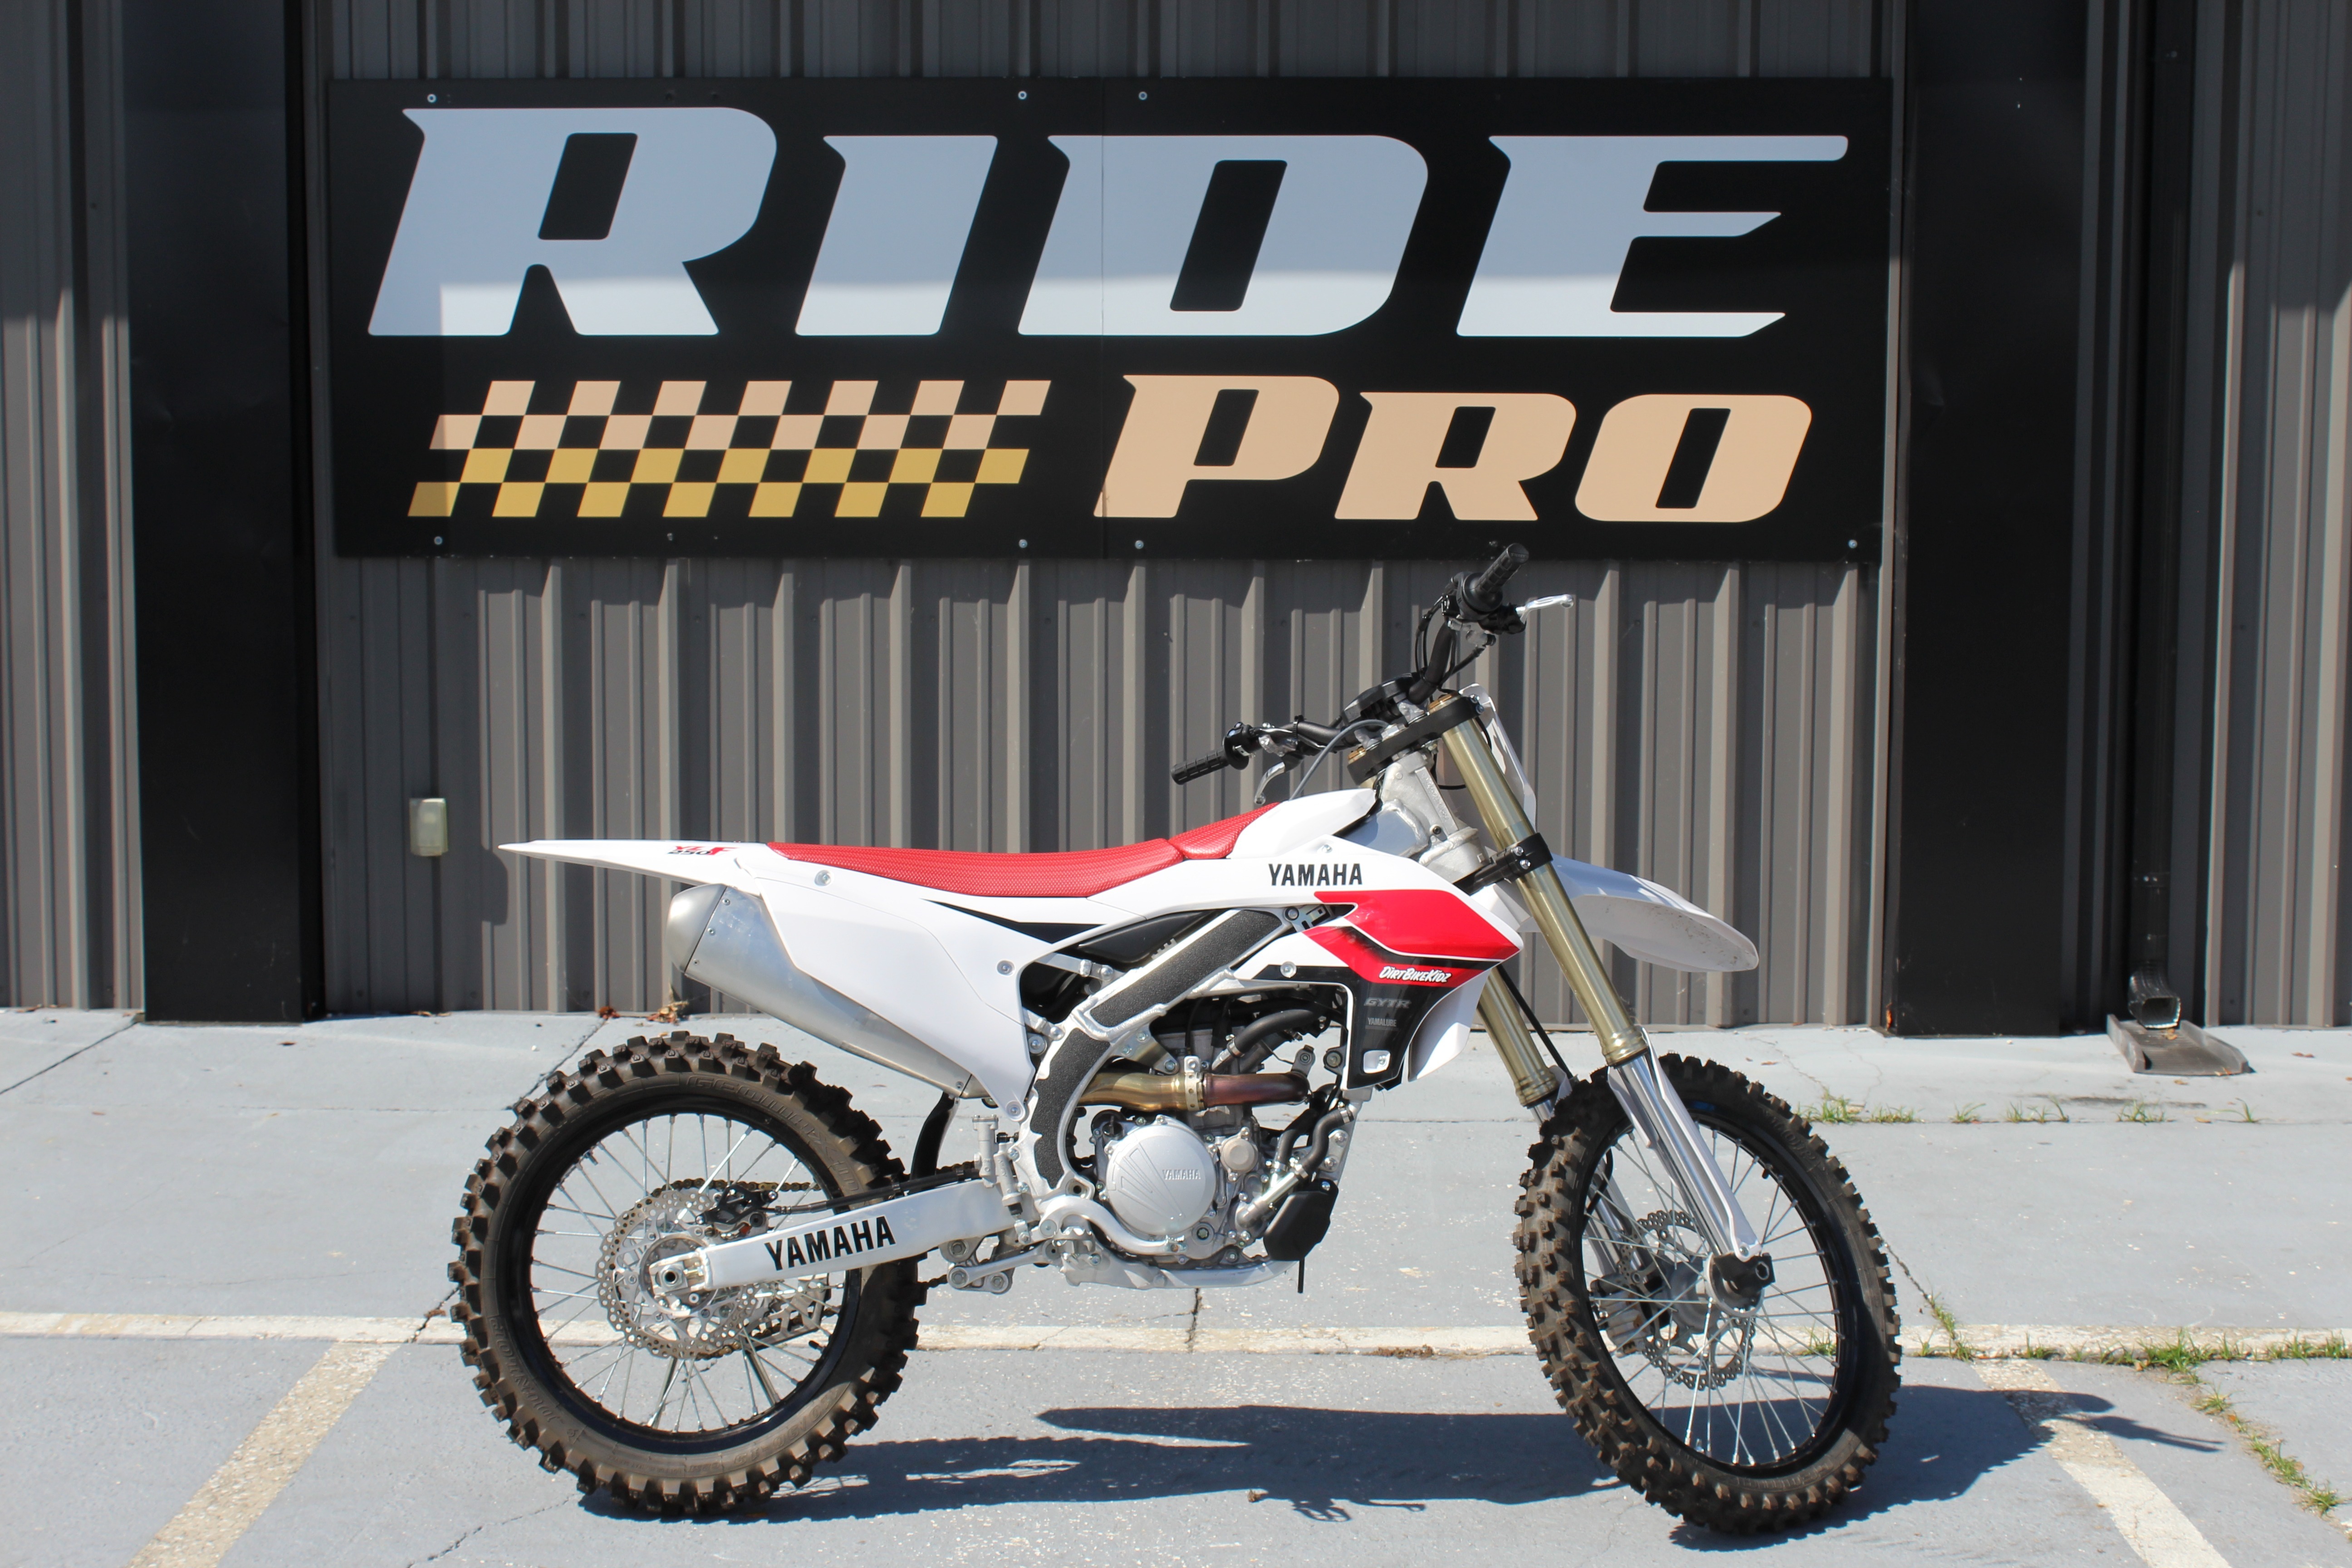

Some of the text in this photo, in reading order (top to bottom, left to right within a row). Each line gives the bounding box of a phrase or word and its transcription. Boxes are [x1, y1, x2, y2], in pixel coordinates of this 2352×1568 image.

[368, 107, 1848, 337] RIDE
[1094, 374, 1813, 523] PRO
[1268, 863, 1363, 887] YAMAHA
[1363, 997, 1410, 1009] GYTR
[1367, 1017, 1397, 1027] YAMALUBE
[1161, 1169, 1201, 1180] YAMAHA
[764, 1215, 896, 1271] YAMAHA
